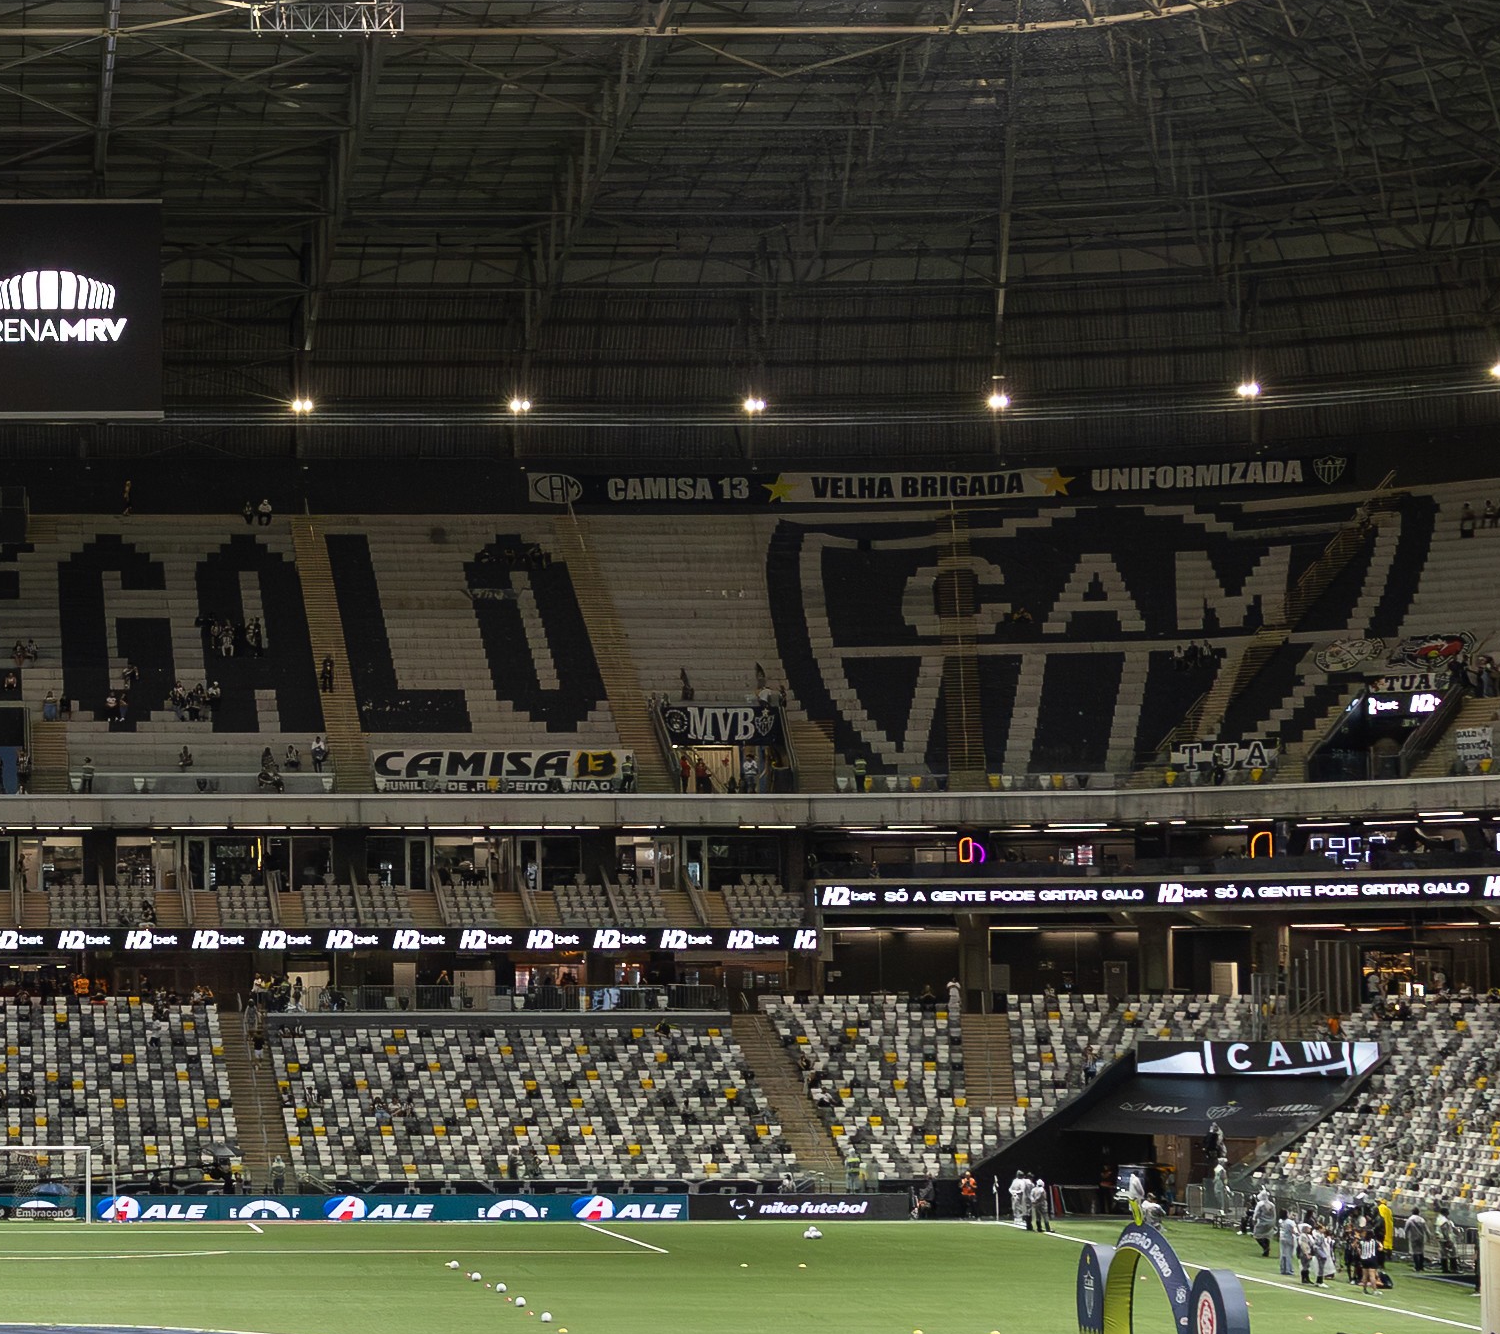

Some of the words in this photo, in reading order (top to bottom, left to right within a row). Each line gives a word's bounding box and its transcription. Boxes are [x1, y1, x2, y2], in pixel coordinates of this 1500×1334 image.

[608, 478, 717, 501] CAMISA
[722, 477, 750, 500] 13
[811, 477, 896, 500] VELHA
[900, 471, 1025, 499] BRIGADA
[1091, 458, 1305, 493] UNIFORMIZADA
[58, 533, 612, 734] GALO
[1384, 673, 1433, 691] TUA
[687, 706, 756, 742] MVB
[373, 750, 571, 779] CAMISA
[573, 750, 616, 779] 13
[1179, 741, 1269, 771] TUA
[884, 887, 908, 902] SÓ
[913, 890, 927, 902] A
[931, 890, 987, 902] GENTE
[990, 890, 1036, 902] PODE
[1039, 889, 1098, 901] GRITAR
[1101, 888, 1144, 901] GALO
[1215, 884, 1239, 899] SÓ
[1242, 886, 1255, 899] A
[1258, 886, 1311, 898] GENTE
[1315, 885, 1359, 897] PODE
[1362, 884, 1419, 896] GRITAR
[1423, 882, 1470, 895] GALO
[1226, 1041, 1332, 1071] CAM
[759, 1201, 800, 1214] nike
[799, 1201, 869, 1214] futebol
